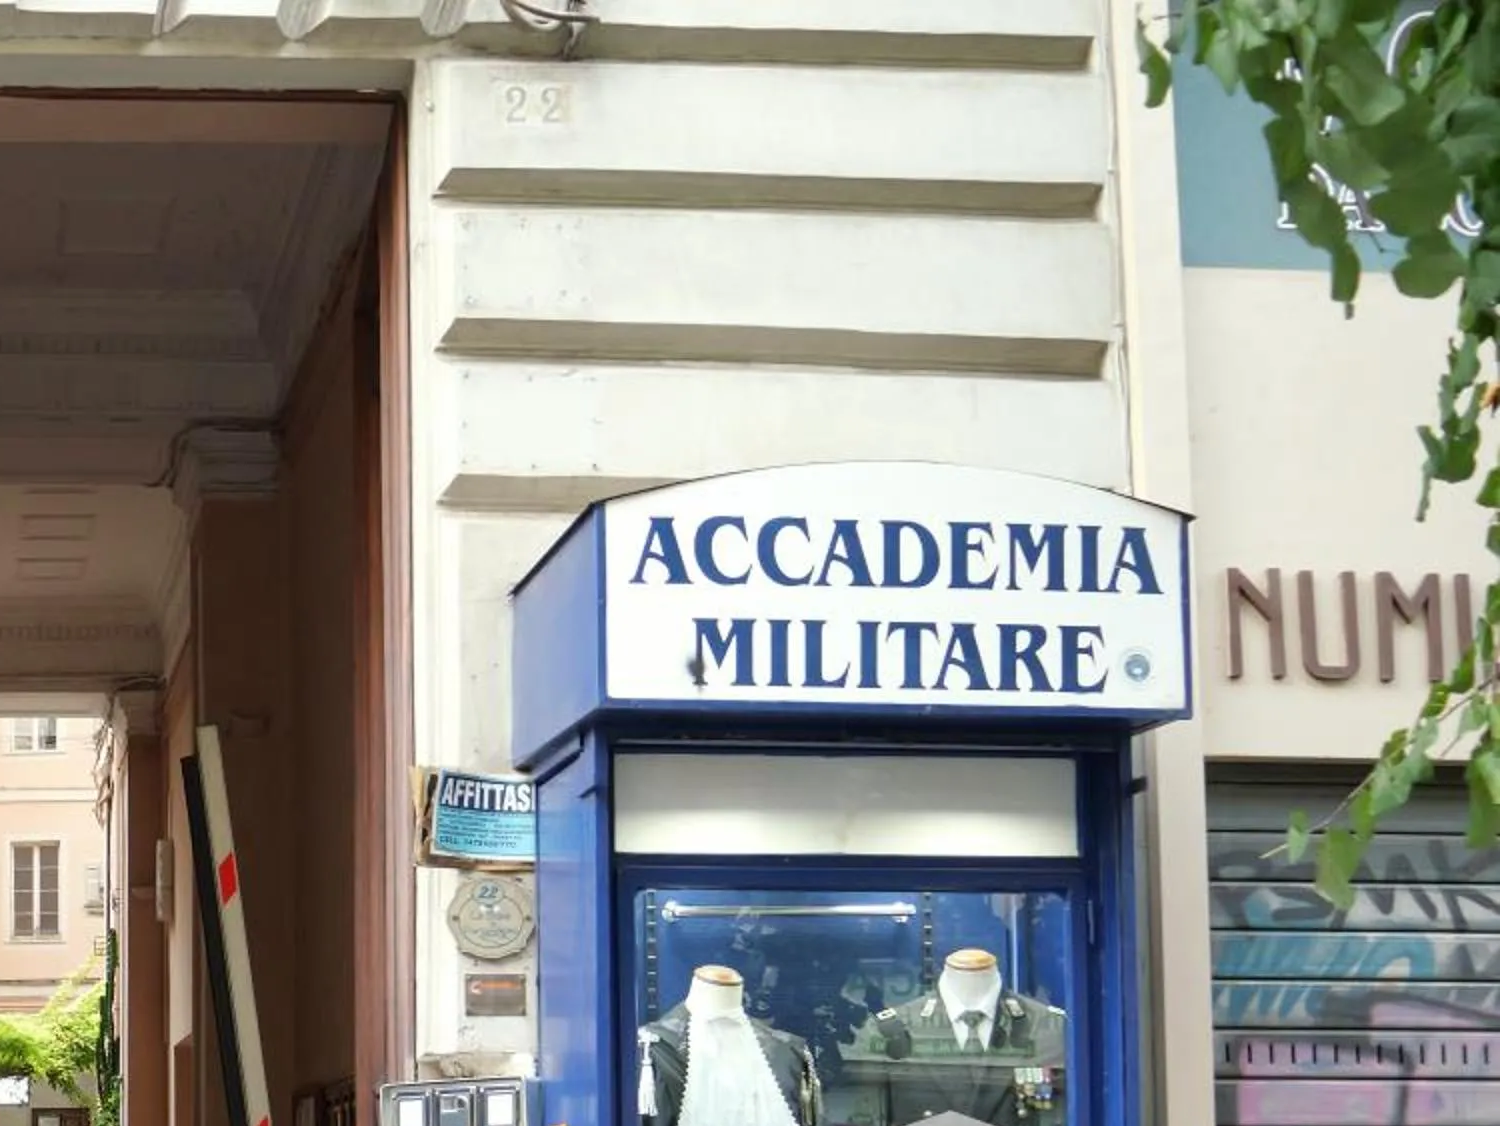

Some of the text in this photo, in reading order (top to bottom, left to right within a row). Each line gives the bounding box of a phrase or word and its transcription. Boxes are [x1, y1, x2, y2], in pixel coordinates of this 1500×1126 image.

[506, 86, 563, 123] 22
[628, 515, 1164, 595] ACCADEMIA
[690, 617, 1110, 694] MILITARE
[1226, 567, 1500, 684] NUMI
[479, 884, 499, 900] 22
